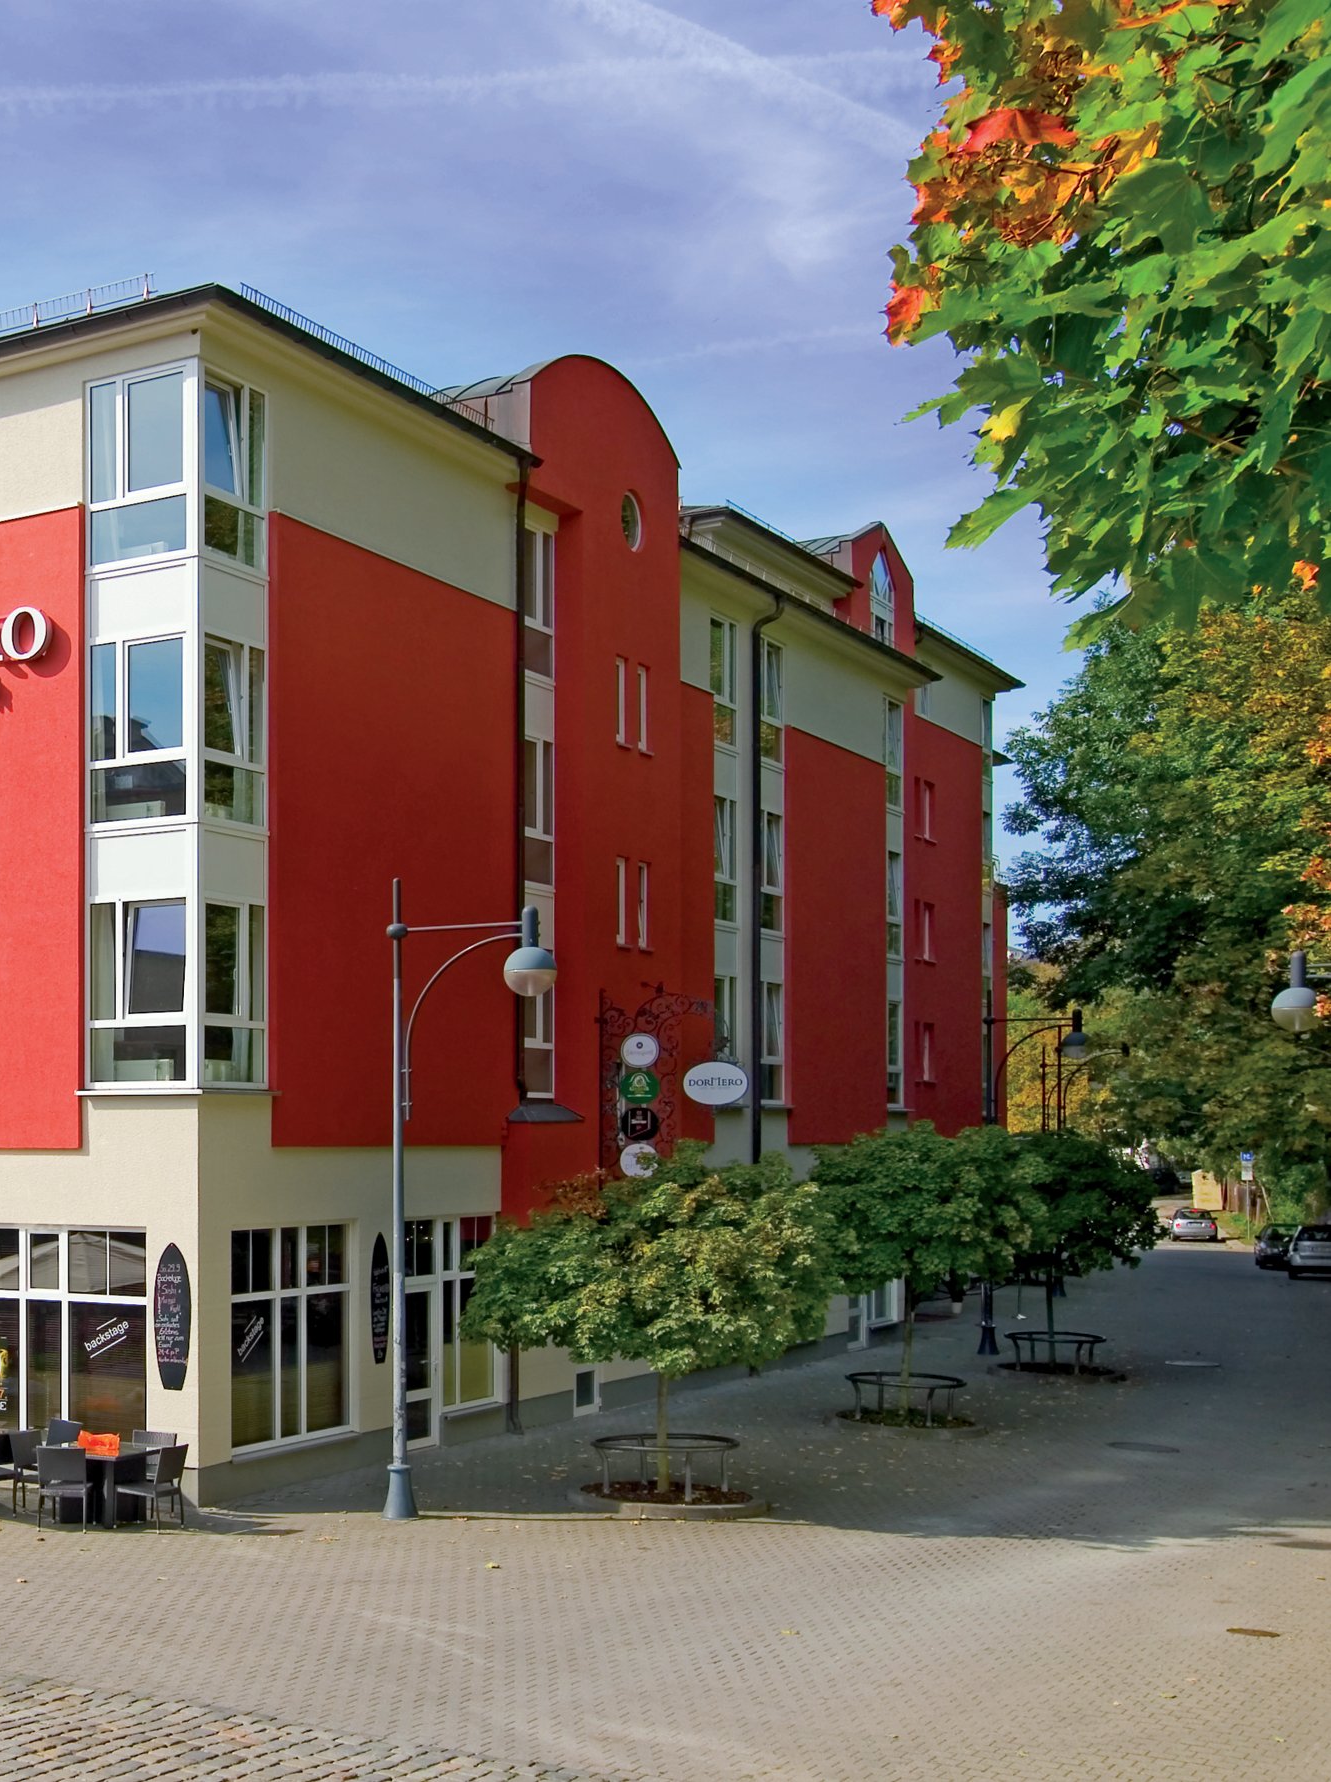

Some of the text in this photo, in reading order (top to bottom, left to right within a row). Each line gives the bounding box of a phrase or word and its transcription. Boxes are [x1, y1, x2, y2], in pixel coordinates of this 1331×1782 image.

[689, 1077, 743, 1087] DORMERO
[84, 1321, 129, 1351] backstage
[237, 1317, 264, 1356] backstage
